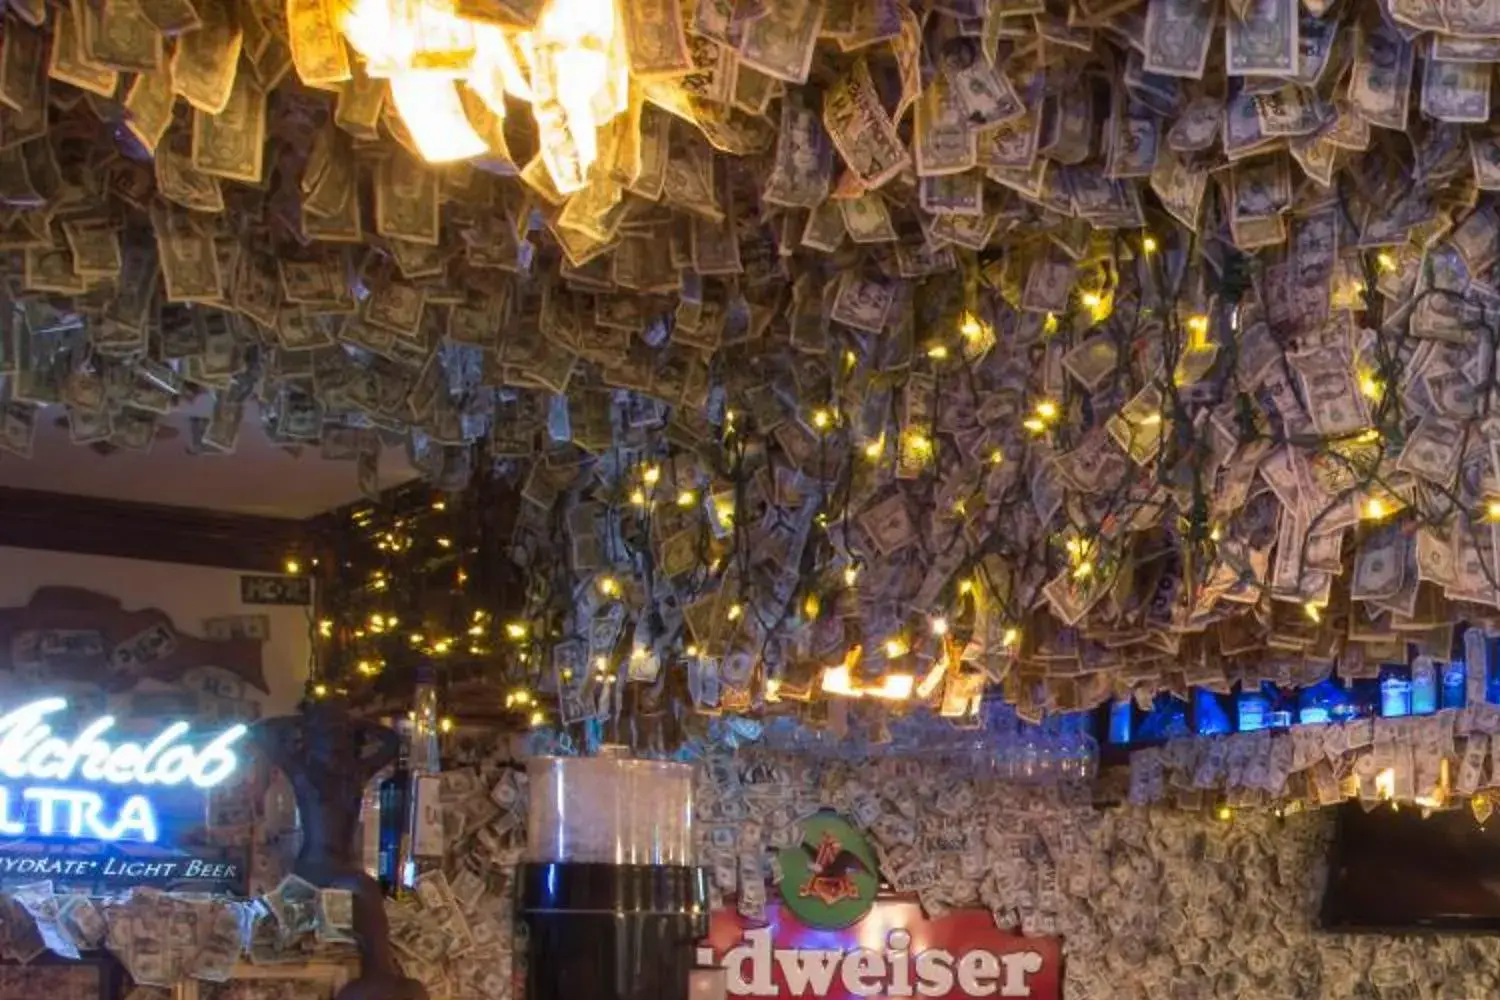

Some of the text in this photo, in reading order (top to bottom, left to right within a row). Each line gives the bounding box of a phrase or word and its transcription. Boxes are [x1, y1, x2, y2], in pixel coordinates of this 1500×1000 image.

[0, 856, 237, 878] YDRATE LIGHT BEER
[697, 925, 1043, 997] dweiser
